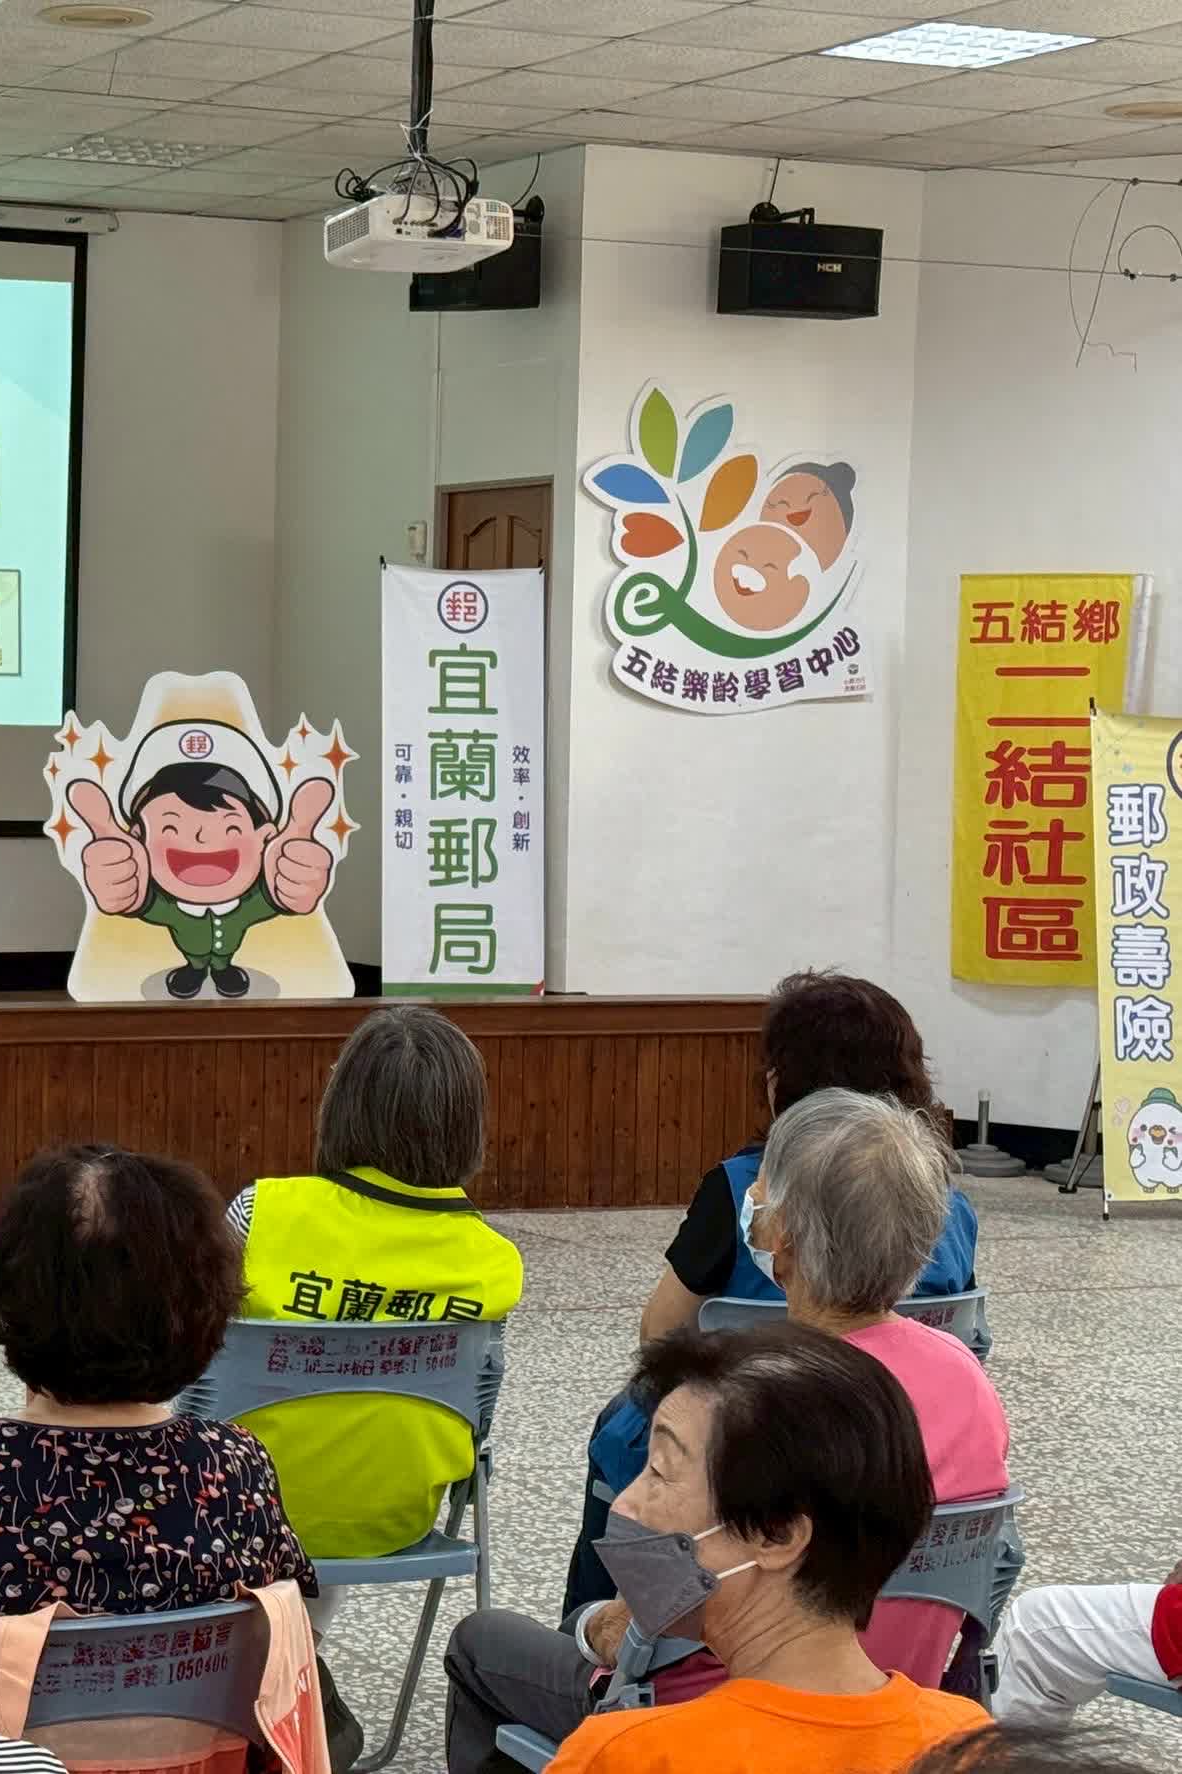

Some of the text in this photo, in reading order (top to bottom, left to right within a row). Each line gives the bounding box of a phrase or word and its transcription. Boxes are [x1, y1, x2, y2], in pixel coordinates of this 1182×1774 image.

[621, 626, 861, 702] 五結樂齡學習中心
[970, 600, 1121, 644] 五結鄉
[427, 642, 499, 975] 宜蘭郵局
[983, 666, 1092, 961] 二結社區
[1106, 783, 1174, 1062] 郵政壽險
